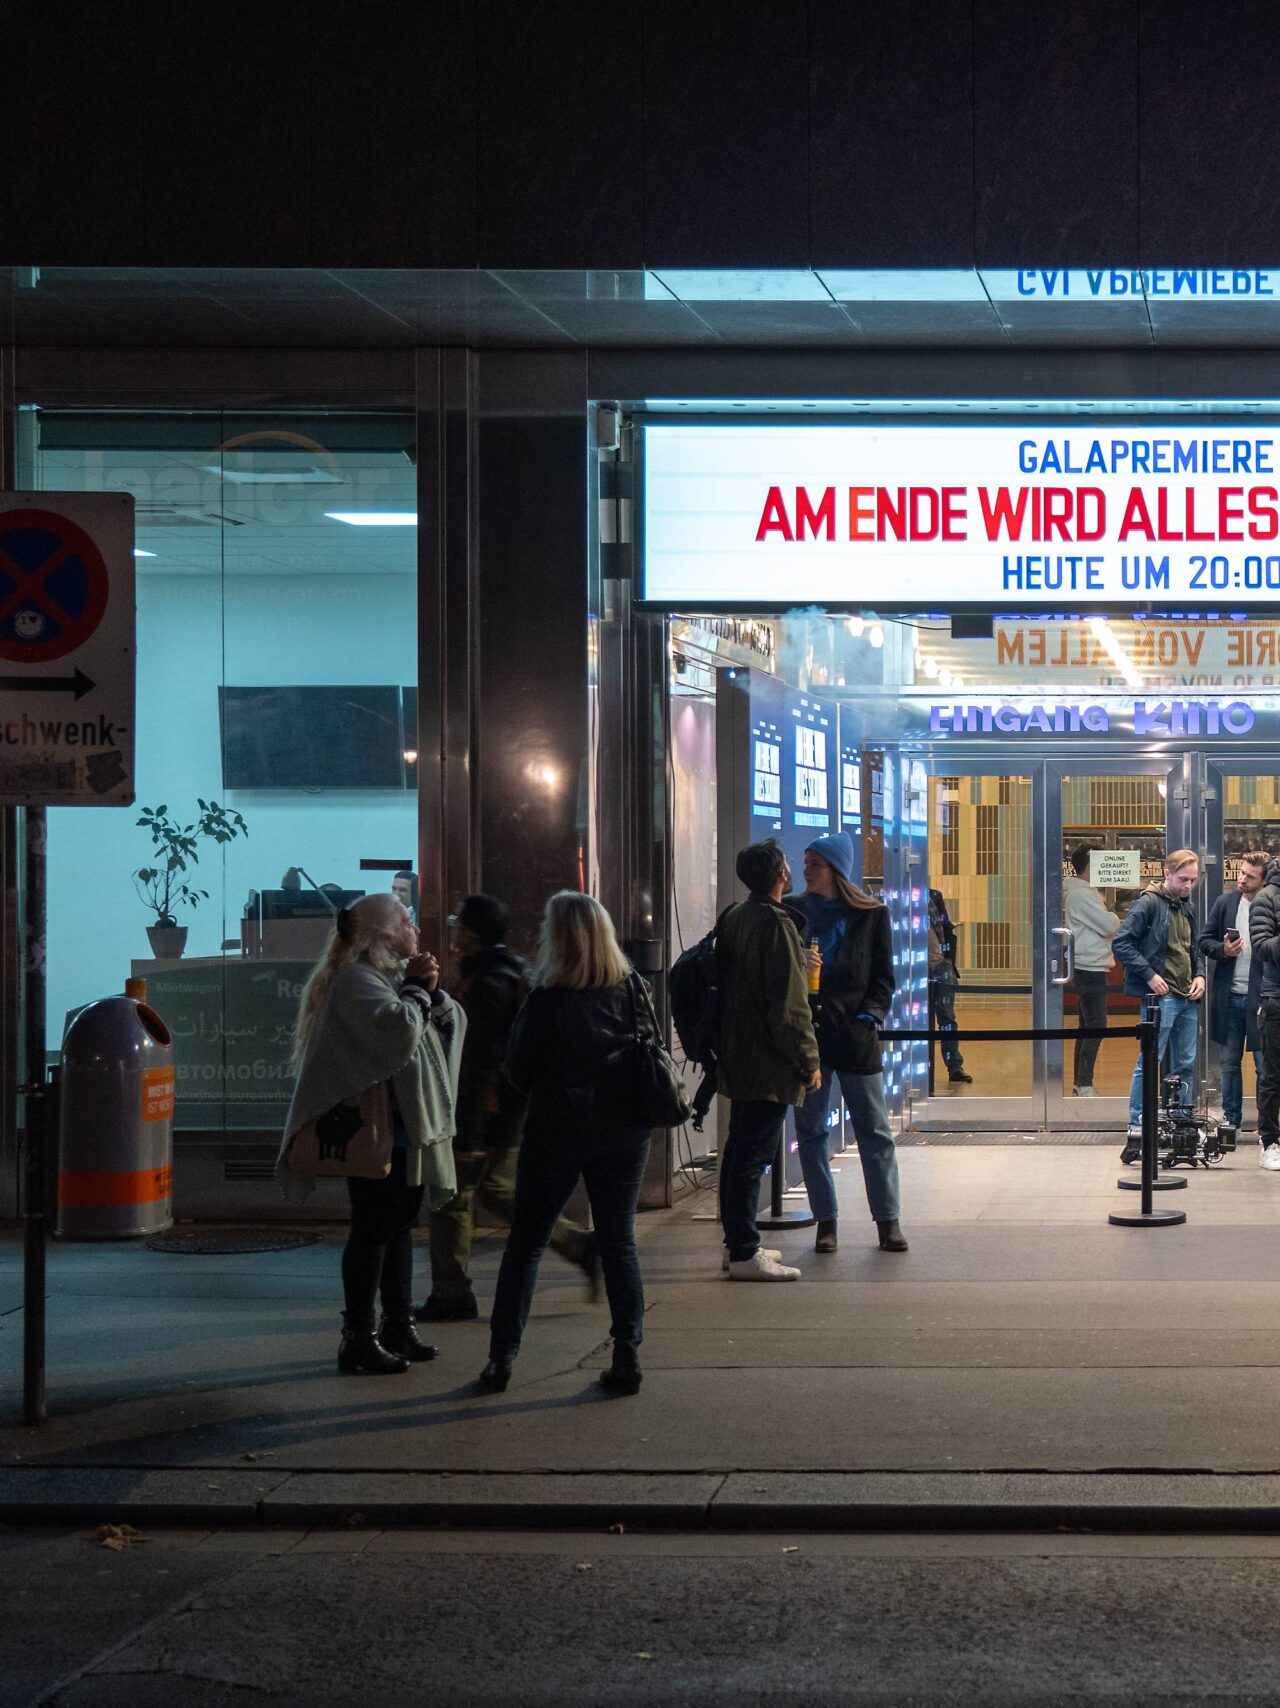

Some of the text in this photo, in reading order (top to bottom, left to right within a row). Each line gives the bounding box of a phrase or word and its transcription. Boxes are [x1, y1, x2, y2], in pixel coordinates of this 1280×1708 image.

[1018, 440, 1274, 473] GALAPREMIERE
[755, 487, 834, 542] AM
[849, 487, 967, 542] ENDE
[978, 487, 1107, 542] WIRD
[1119, 486, 1278, 541] ALLES
[1002, 557, 1104, 590] HEUTE
[1122, 557, 1171, 590] UM
[0, 713, 127, 746] chwenk-
[930, 705, 1109, 732] EINGANG
[1133, 701, 1256, 735] KINO
[156, 982, 221, 994] Mietwagen
